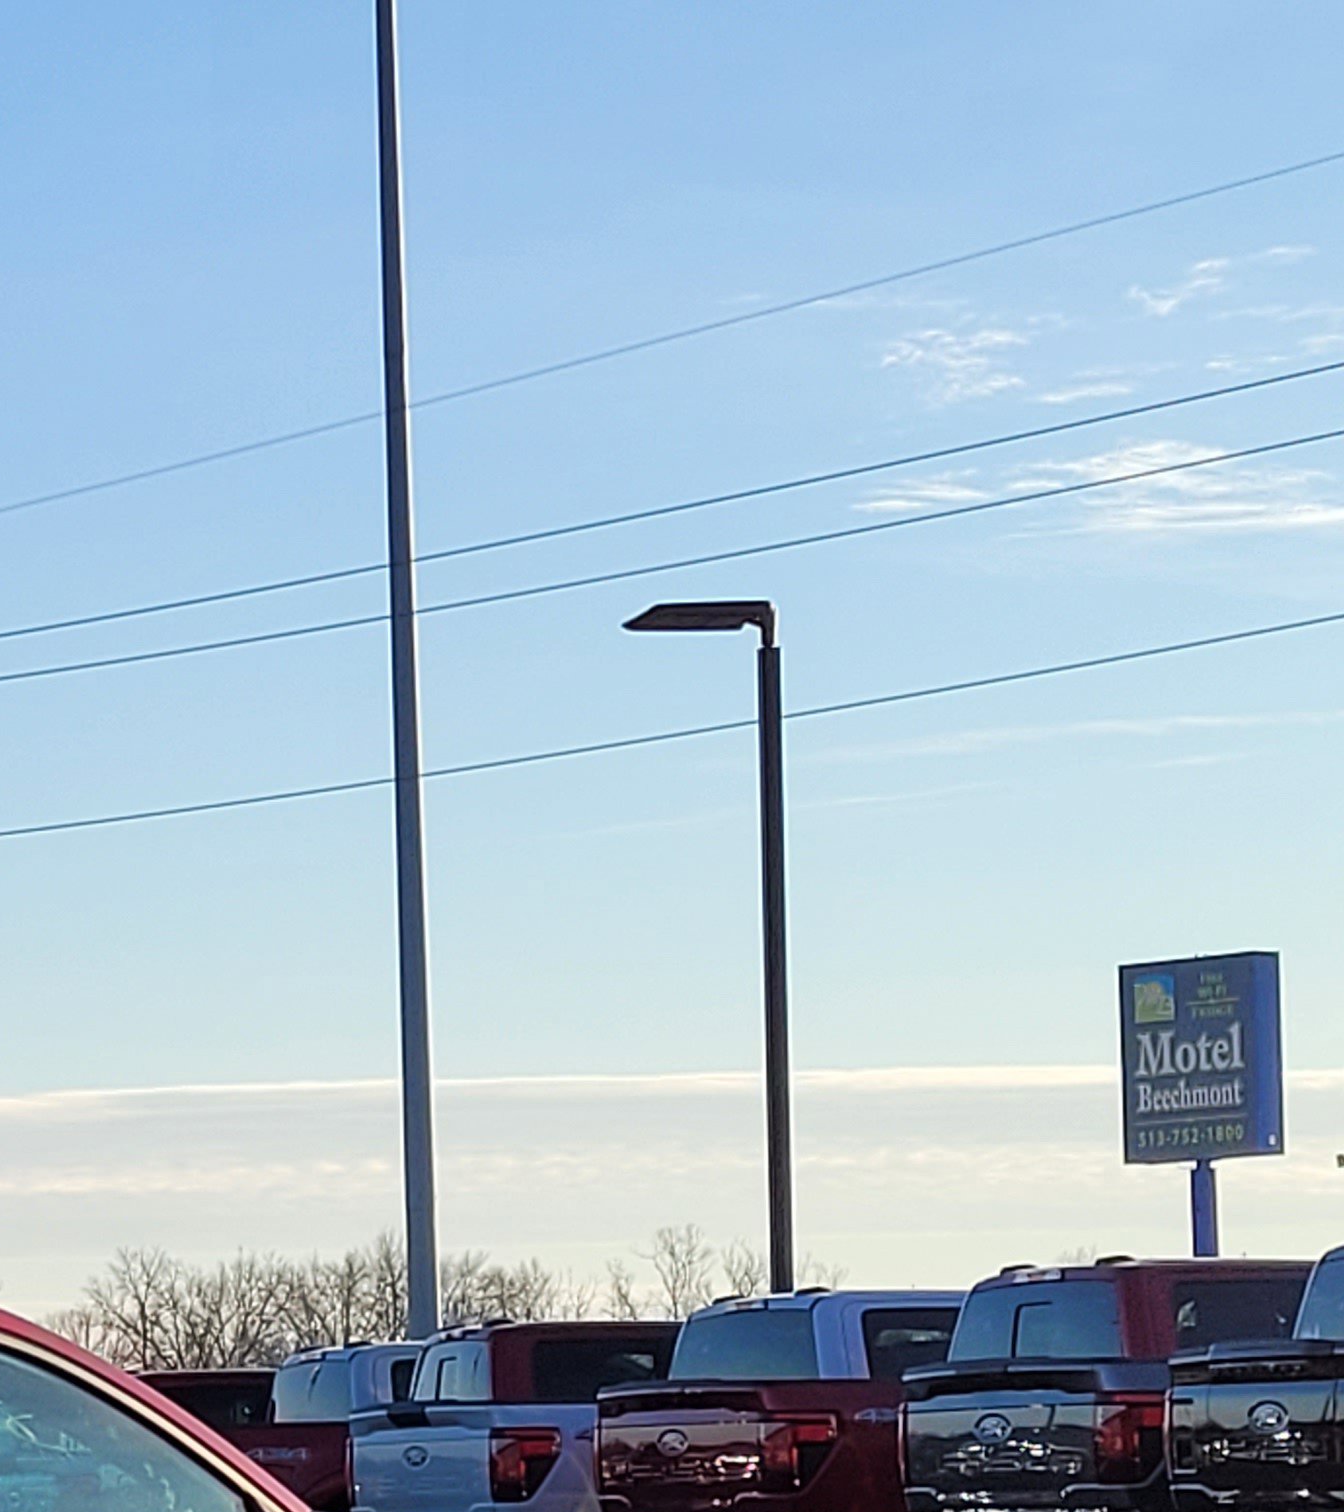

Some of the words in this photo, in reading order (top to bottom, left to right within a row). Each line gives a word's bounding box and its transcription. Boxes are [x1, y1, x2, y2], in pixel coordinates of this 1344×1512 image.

[1134, 1021, 1245, 1077] Motel
[1136, 1077, 1243, 1113] Beechmont
[1137, 1123, 1245, 1148] 513-752-1800
